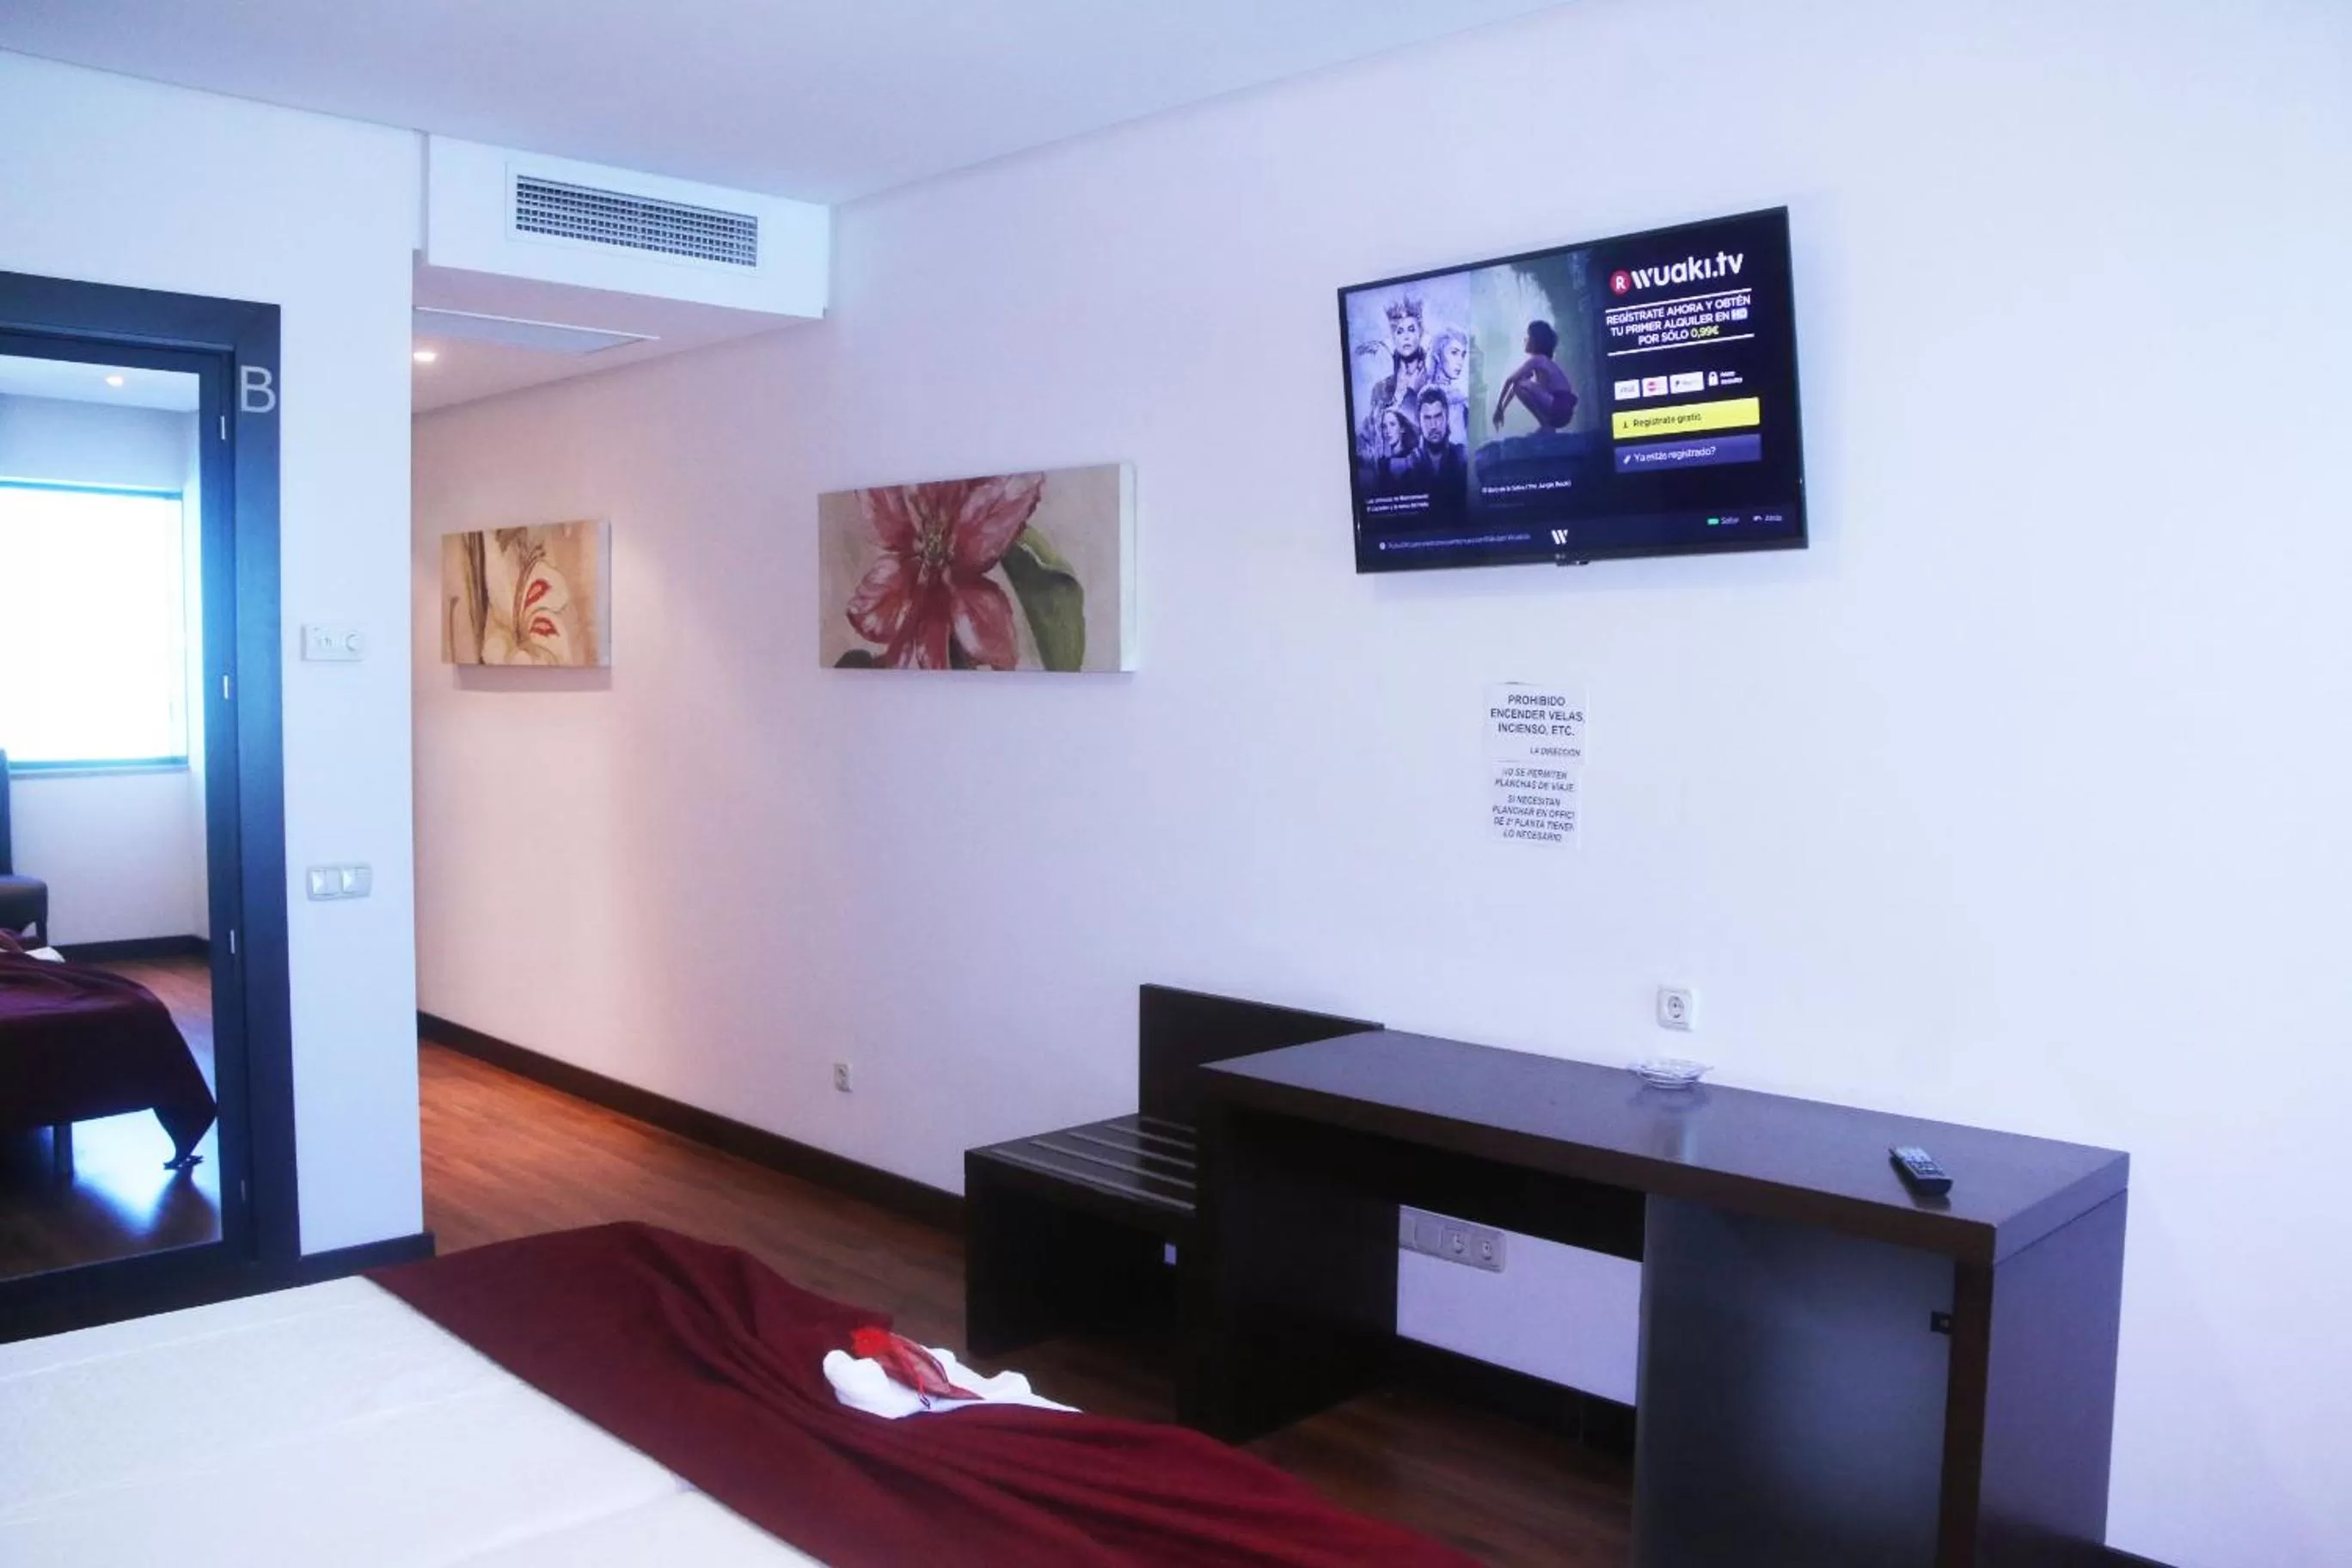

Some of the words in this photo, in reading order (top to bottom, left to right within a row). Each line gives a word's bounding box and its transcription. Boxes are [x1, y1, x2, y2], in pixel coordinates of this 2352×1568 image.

[1606, 308, 1664, 325] REGÍSTRATE
[1667, 302, 1704, 316] AHORA
[1705, 299, 1713, 309] Y
[1715, 294, 1751, 308] OBTÉN
[1610, 327, 1624, 337] TU
[1626, 321, 1663, 334] PRIMER
[1663, 314, 1713, 329] ALQUILER
[1715, 311, 1730, 322] EN
[1638, 334, 1659, 346] POR
[1662, 329, 1689, 342] SÓLO
[241, 364, 276, 413] B
[1508, 695, 1565, 706] PROHIBIDO
[1490, 708, 1546, 720] ENCENDER
[1548, 711, 1585, 724] VELAS,
[1498, 723, 1548, 736] INCIENSO,
[1551, 726, 1575, 736] ETC.
[1515, 768, 1526, 776] SE
[1495, 778, 1536, 789] PLANCHAS
[1492, 805, 1534, 816] PLANCHAR
[1536, 809, 1547, 818] EN
[1514, 818, 1545, 828] PLANTA
